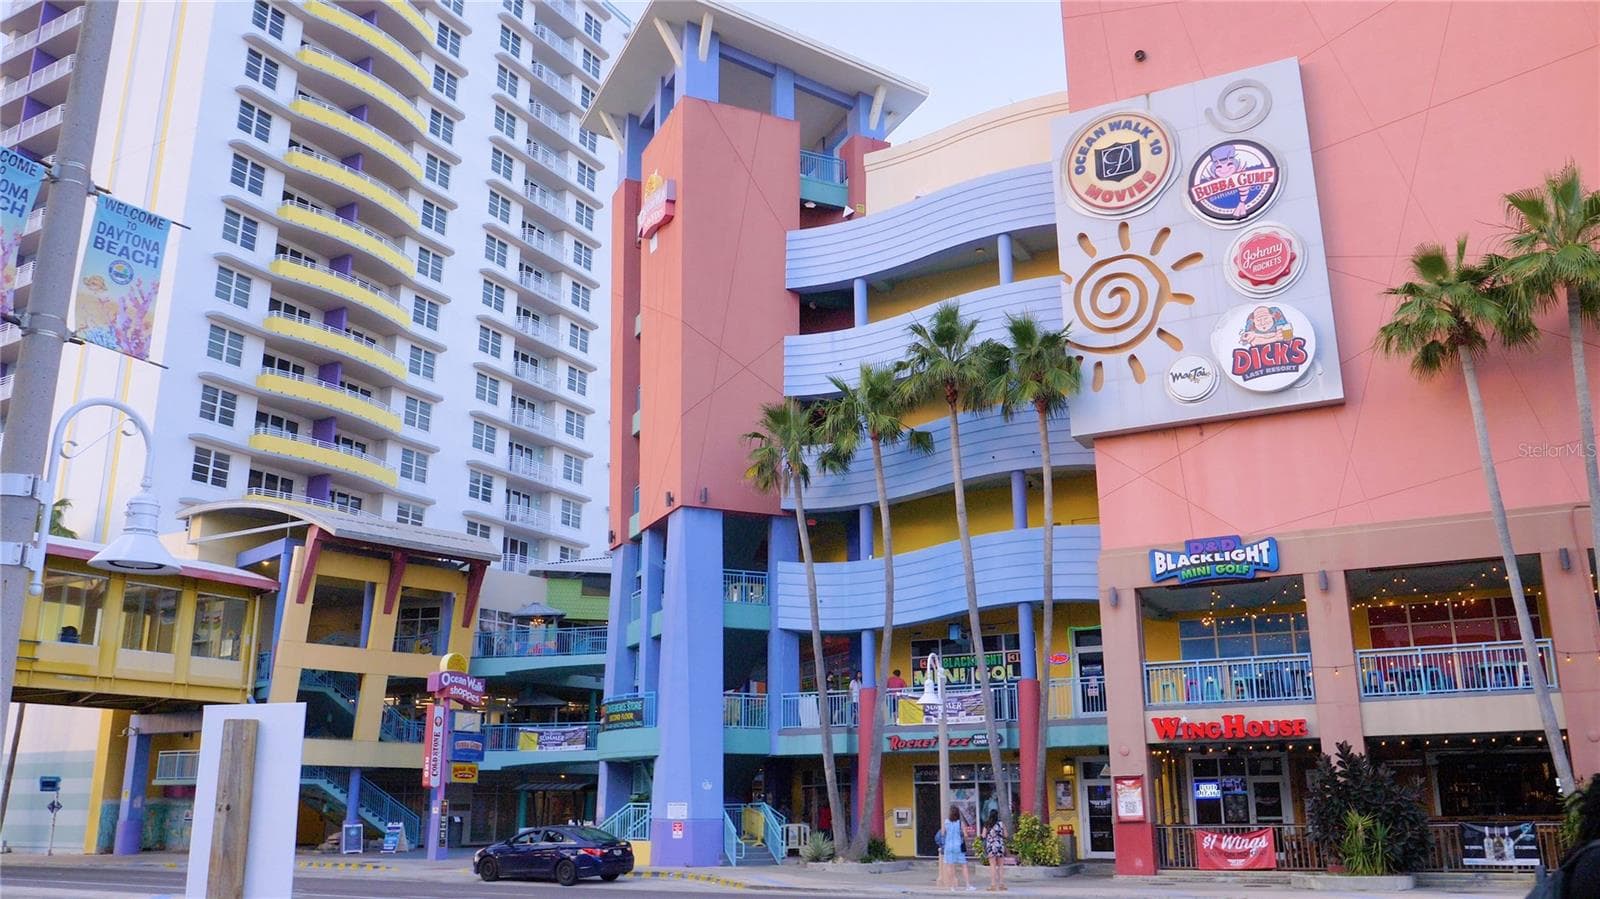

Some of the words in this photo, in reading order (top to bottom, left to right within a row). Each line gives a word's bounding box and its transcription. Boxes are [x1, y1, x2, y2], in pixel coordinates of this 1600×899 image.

[1074, 127, 1106, 175] OCEAN
[1108, 120, 1154, 138] WALK
[1149, 139, 1163, 156] 10
[1084, 170, 1157, 203] MOVIES
[1194, 178, 1236, 199] BUBBA
[1237, 171, 1274, 186] GUMP
[104, 198, 166, 230] WELCOME
[127, 221, 137, 231] TO
[97, 221, 160, 255] DAYTONA
[93, 235, 159, 269] BEACH
[1242, 242, 1283, 269] Johnny
[1252, 256, 1282, 273] ROCKETS
[1232, 337, 1308, 376] DICK'S
[1244, 369, 1265, 380] LAST
[1265, 365, 1297, 374] RESORT
[1154, 540, 1270, 575] BLACKLIGHT
[1181, 567, 1212, 580] MINI
[1215, 564, 1251, 575] GOLF
[441, 672, 467, 686] Ocean
[467, 676, 483, 692] Walk
[976, 665, 1021, 683] GOL
[450, 686, 479, 702] shoppes
[432, 731, 441, 757] STONE
[887, 735, 938, 751] ROCKET
[431, 757, 439, 777] COLD
[1202, 834, 1217, 850] $1
[1221, 834, 1269, 858] Wings
